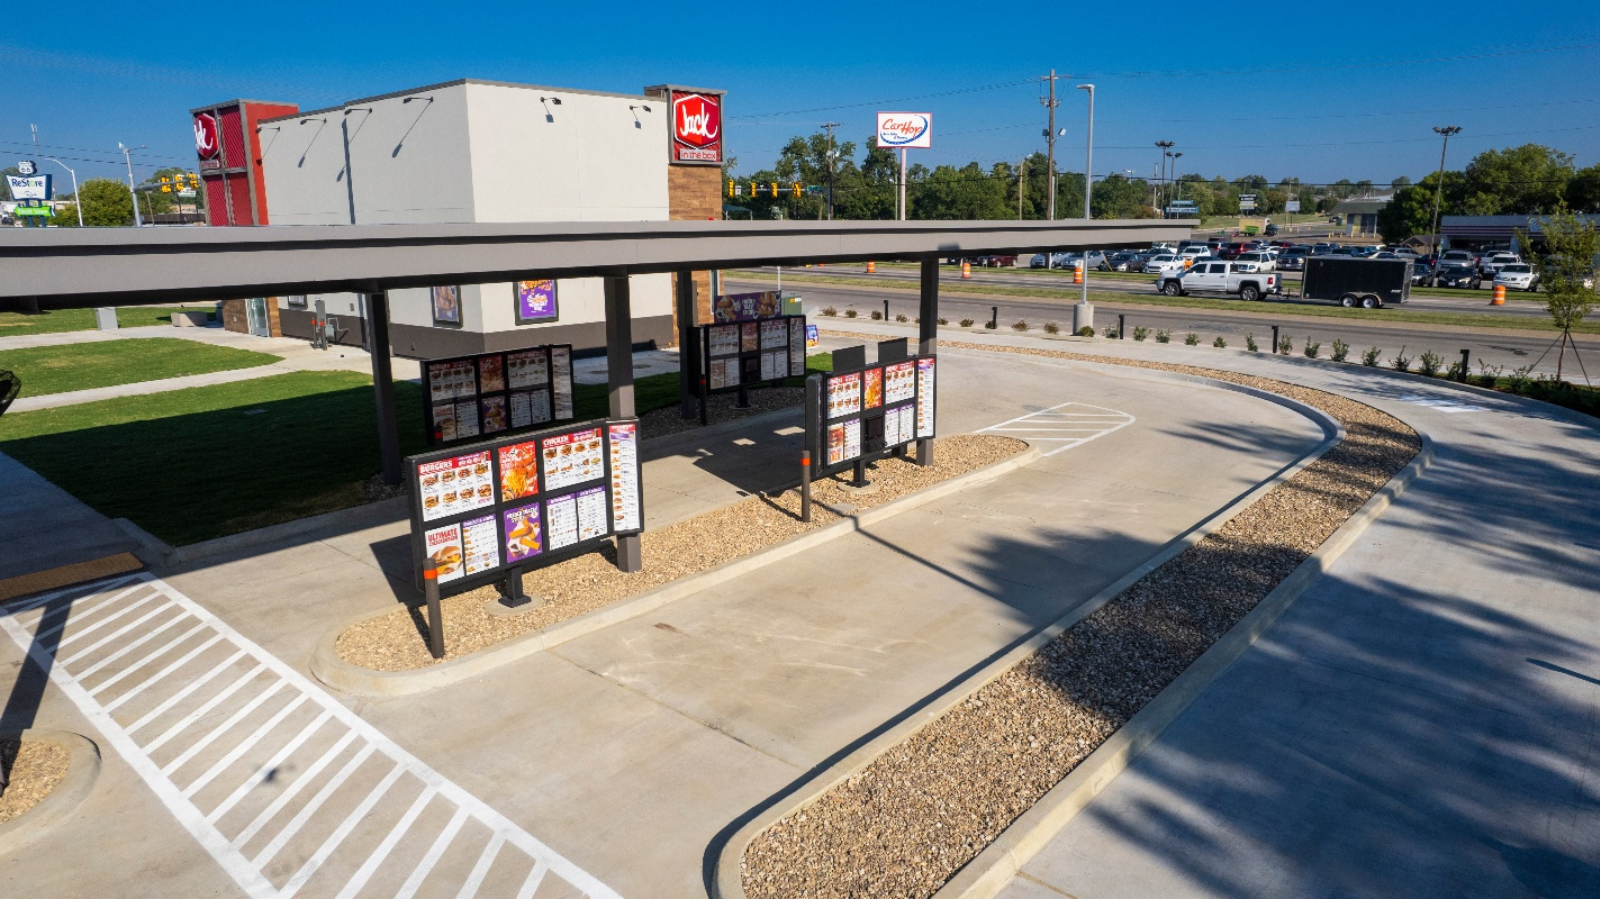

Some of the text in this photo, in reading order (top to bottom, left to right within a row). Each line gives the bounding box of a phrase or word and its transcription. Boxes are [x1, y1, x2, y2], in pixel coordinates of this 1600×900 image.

[680, 103, 718, 138] Jack
[882, 118, 923, 139] CarHop
[681, 150, 716, 159] in the box
[11, 178, 43, 188] ReStore
[420, 460, 453, 473] BURGERS
[427, 528, 458, 542] ULTIMATE
